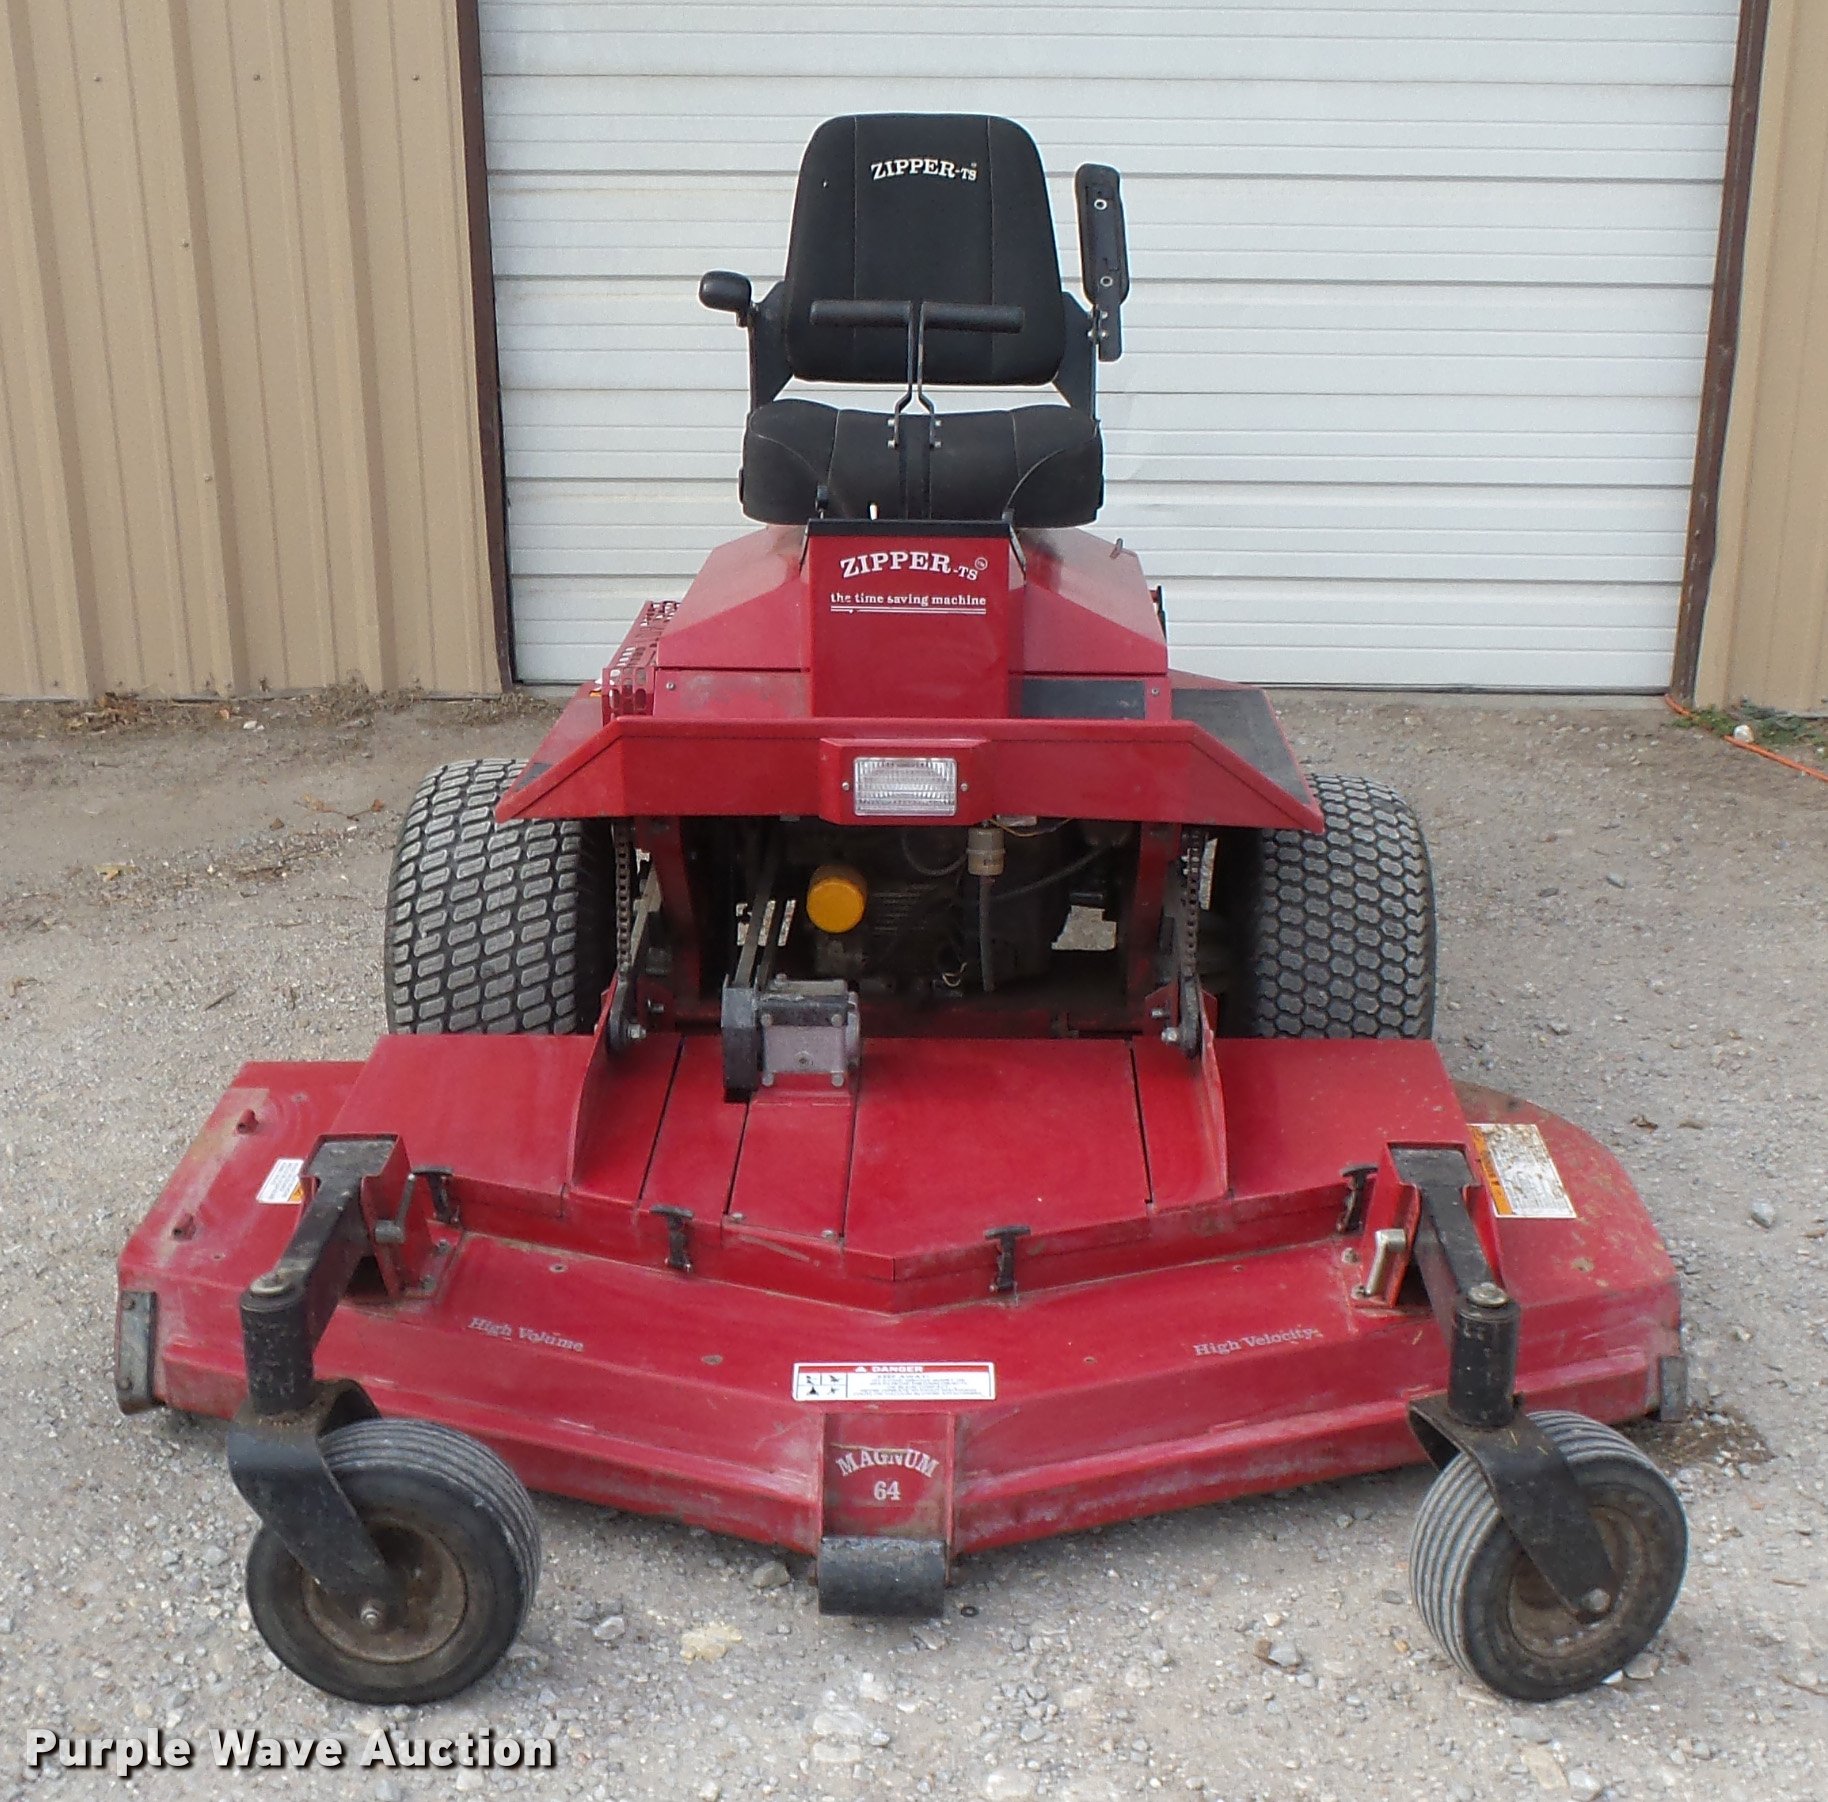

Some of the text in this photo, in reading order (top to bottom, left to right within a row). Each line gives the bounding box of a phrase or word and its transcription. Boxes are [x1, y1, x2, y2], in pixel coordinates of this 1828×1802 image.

[870, 158, 978, 181] ZIPPER-TS
[831, 592, 987, 607] the time saving machine
[1193, 1327, 1315, 1356] High Velocity
[836, 1448, 939, 1478] MAGNUM
[874, 1481, 901, 1501] 64
